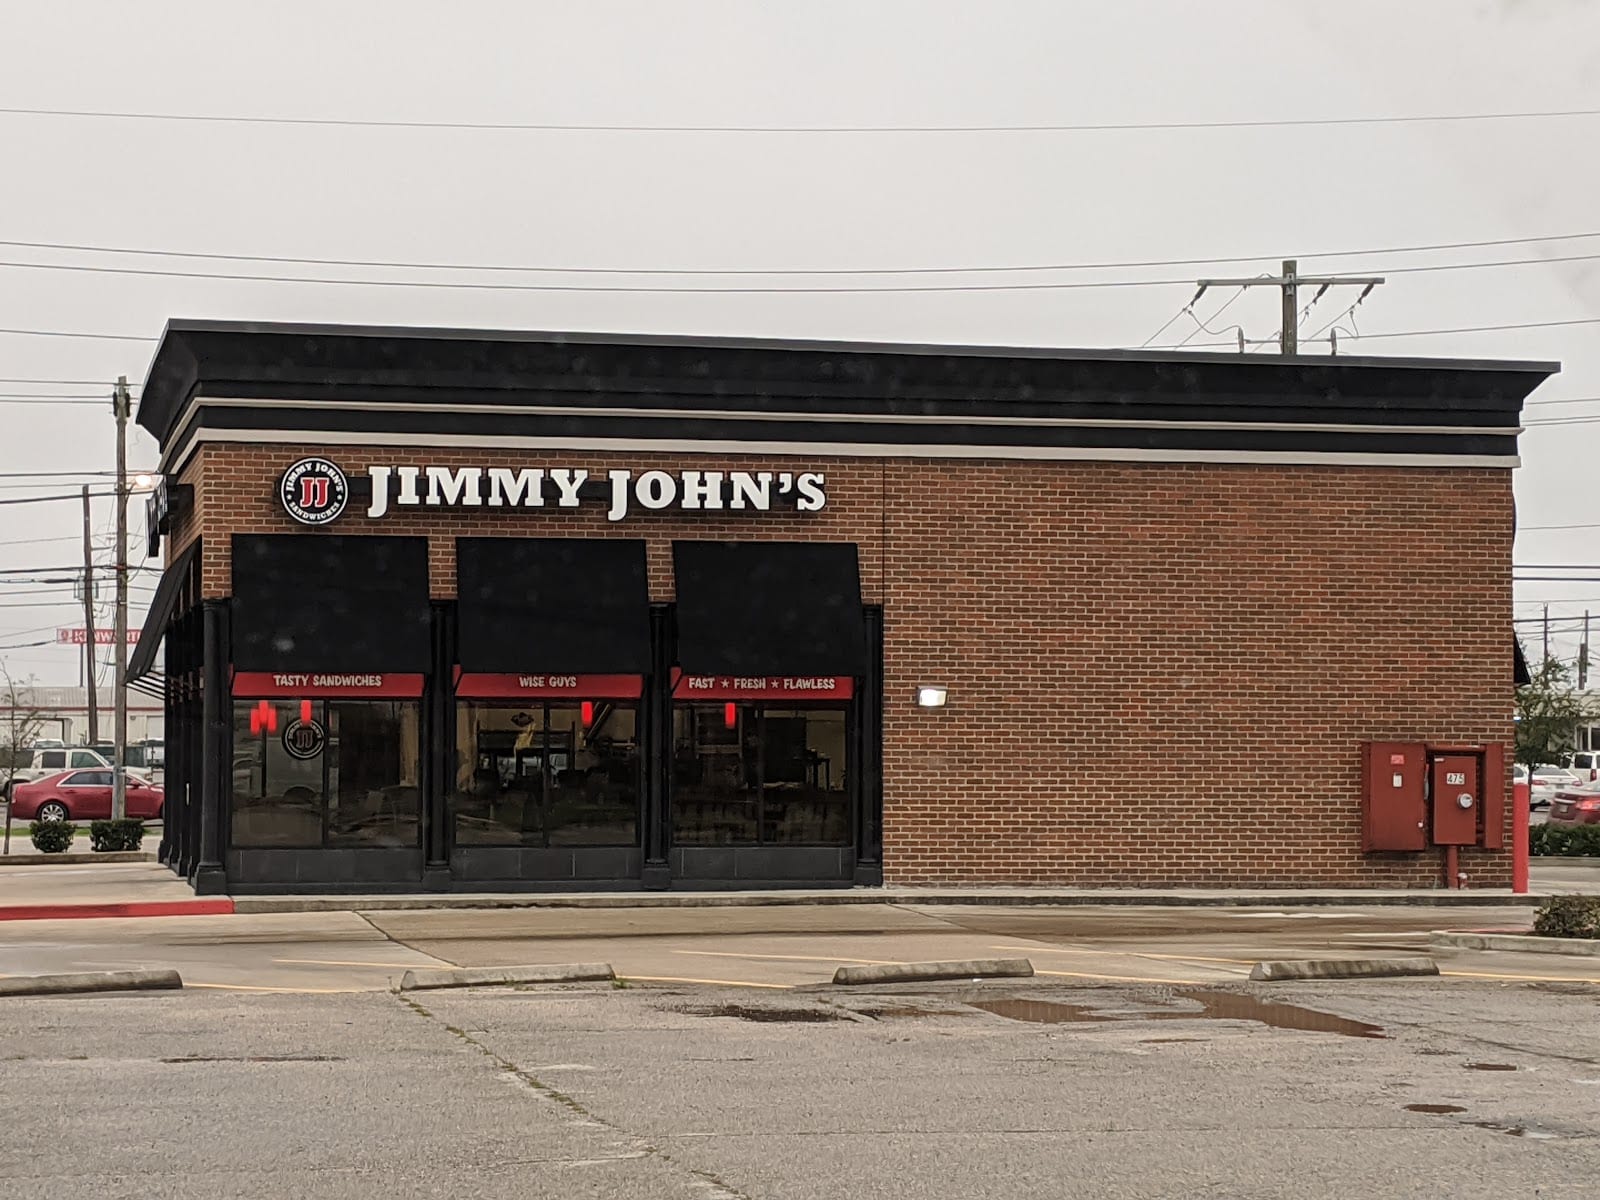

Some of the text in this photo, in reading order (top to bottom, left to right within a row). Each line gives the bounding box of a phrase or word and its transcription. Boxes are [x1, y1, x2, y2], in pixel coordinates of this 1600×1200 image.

[286, 462, 344, 493] JIMMY JOHN'S
[300, 476, 330, 508] JJ
[367, 465, 826, 522] JIMMY JOHN'S
[273, 674, 382, 687] TASTY SANDWICHES
[519, 676, 577, 688] WISE GUYS
[688, 678, 836, 690] FAST FRESH FLAWLESS
[1447, 773, 1465, 784] 475
